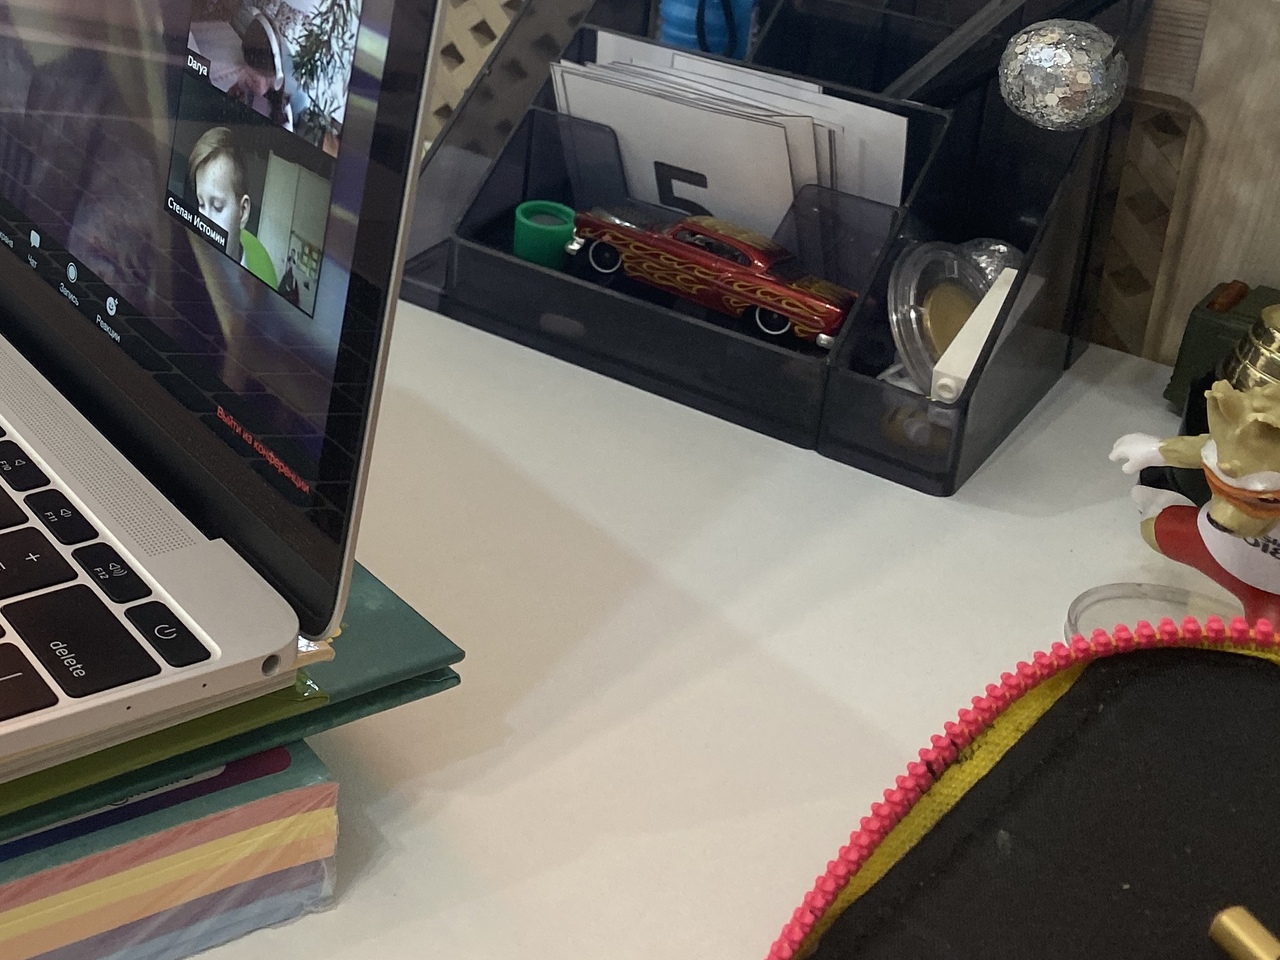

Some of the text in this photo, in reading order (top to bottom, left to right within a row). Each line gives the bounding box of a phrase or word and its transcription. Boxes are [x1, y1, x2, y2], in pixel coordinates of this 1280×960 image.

[187, 54, 208, 76] Darya
[167, 196, 226, 247] Степан Истомин
[59, 281, 80, 307] Запись
[95, 314, 121, 343] Реакции
[216, 405, 310, 495] Выйти из конференции
[44, 511, 59, 523] F11
[93, 566, 109, 580] F12
[49, 640, 86, 678] delete
